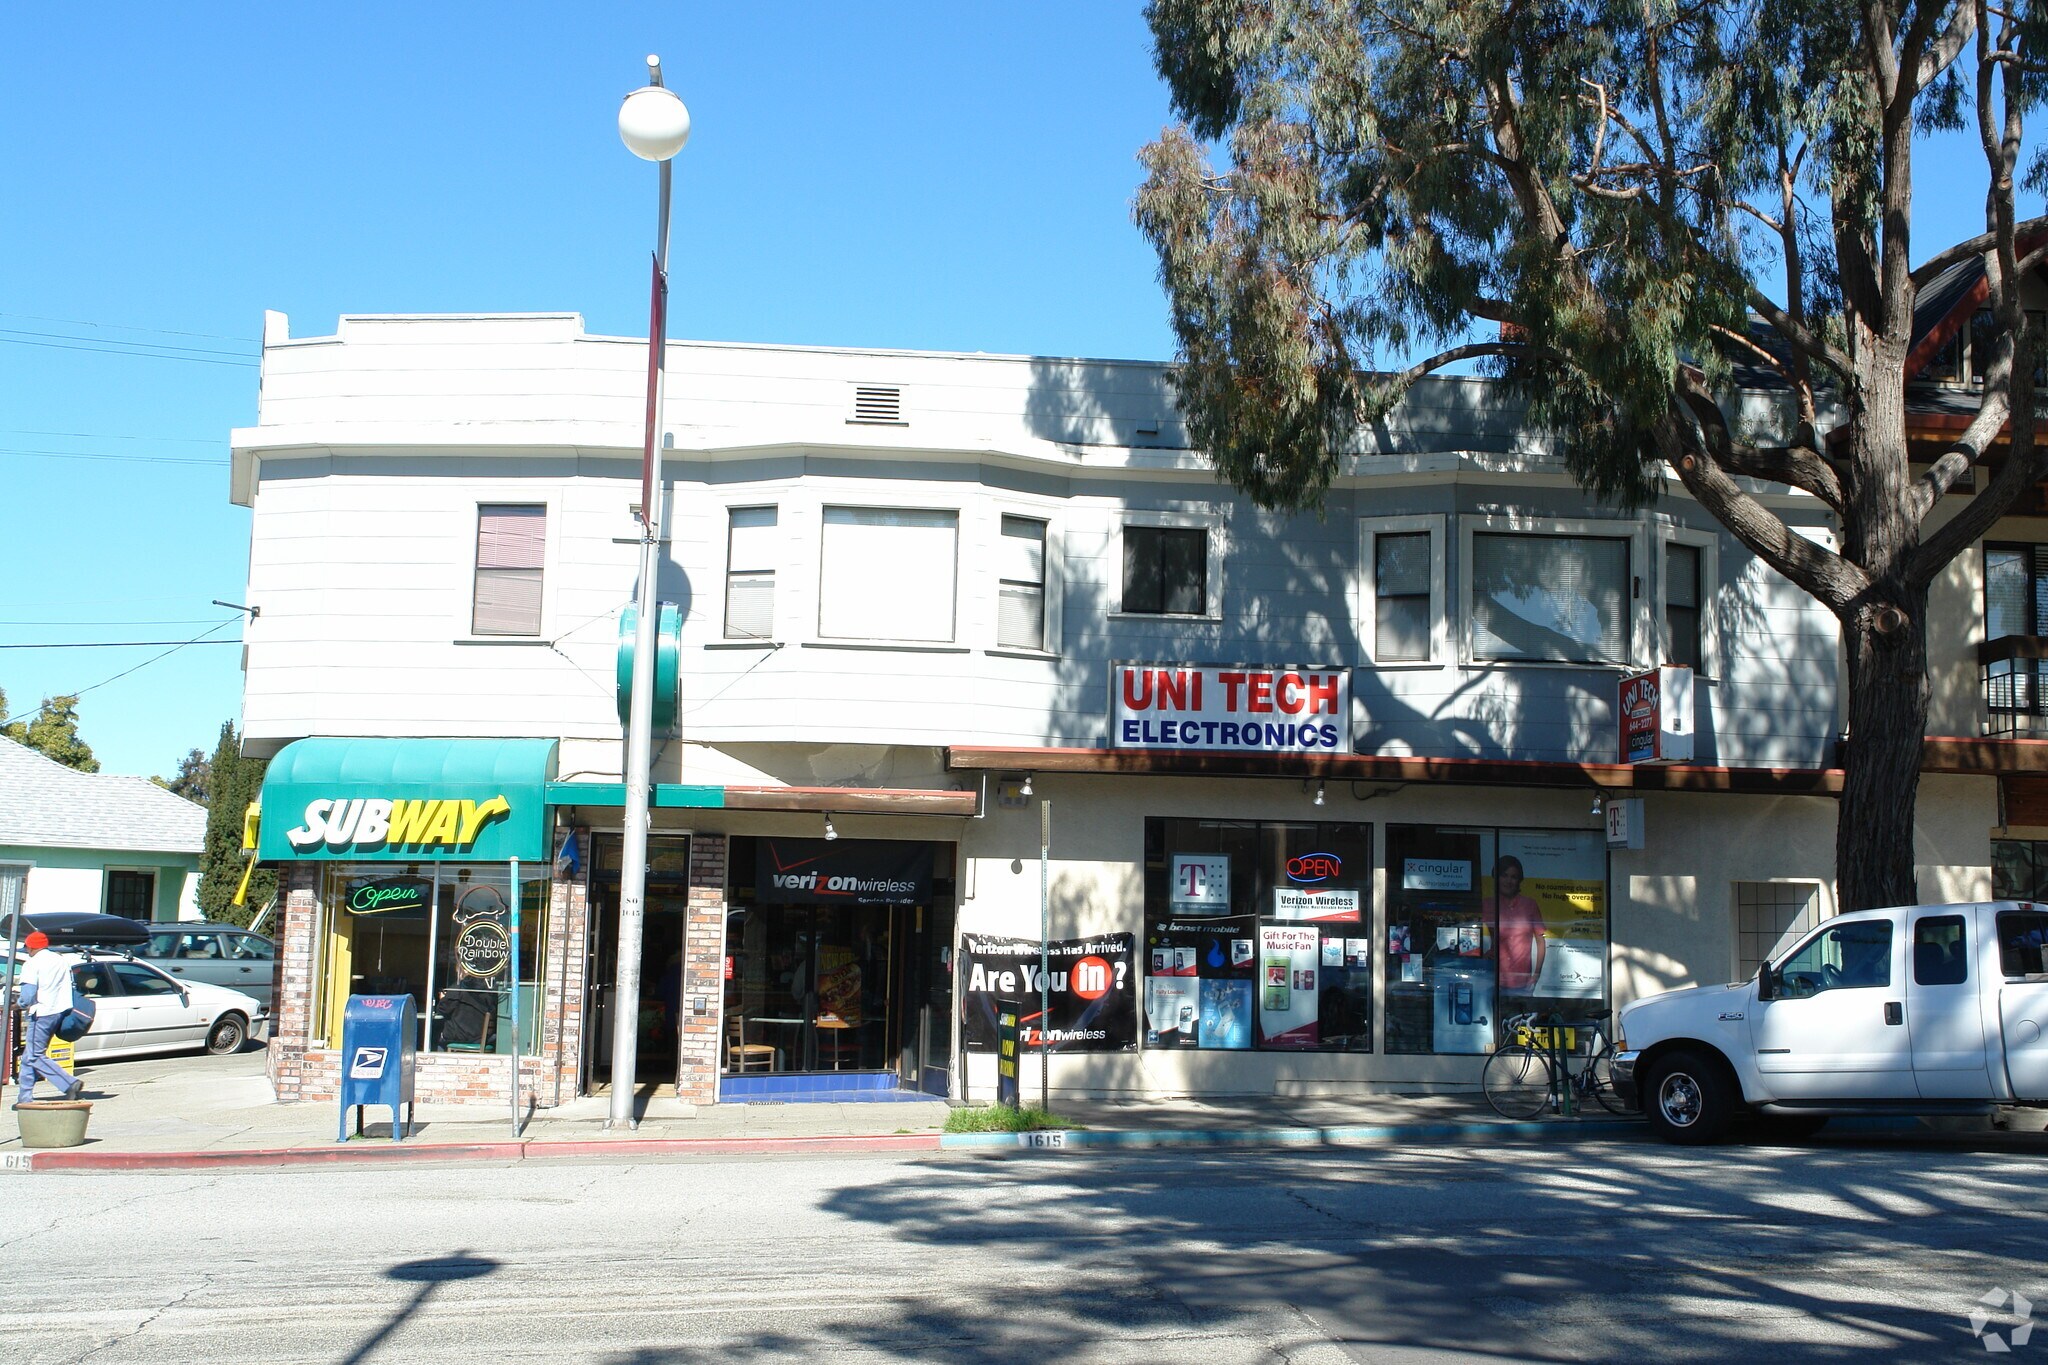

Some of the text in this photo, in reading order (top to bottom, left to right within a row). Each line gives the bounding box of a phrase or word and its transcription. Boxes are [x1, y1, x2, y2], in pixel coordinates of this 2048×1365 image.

[1123, 669, 1338, 715] UNI TECH
[1623, 679, 1659, 716] UNI TECH
[1122, 719, 1338, 748] ELECTRONICS
[1631, 732, 1654, 750] cingular
[286, 794, 511, 847] SUBWAY
[1286, 857, 1339, 877] OPEN
[1418, 861, 1464, 876] cingular
[1180, 863, 1206, 897] T
[1450, 880, 1469, 888] Agent
[1546, 883, 1575, 892] roaming
[1576, 885, 1602, 893] charges
[353, 885, 419, 909] Open
[1280, 895, 1354, 906] Verizon Wireless
[1553, 892, 1570, 902] huge
[1571, 894, 1602, 903] overages
[1169, 922, 1240, 934] boost mobile
[1263, 931, 1316, 941] Gift For The
[464, 934, 508, 950] Double
[968, 938, 1013, 955] Verizon
[1062, 944, 1083, 955] Has
[1084, 940, 1127, 955] Arrived.
[1266, 941, 1312, 951] Music Fan
[458, 946, 511, 961] Rainbow
[967, 961, 1127, 993] Are You in ?
[1027, 1134, 1062, 1148] 1615
